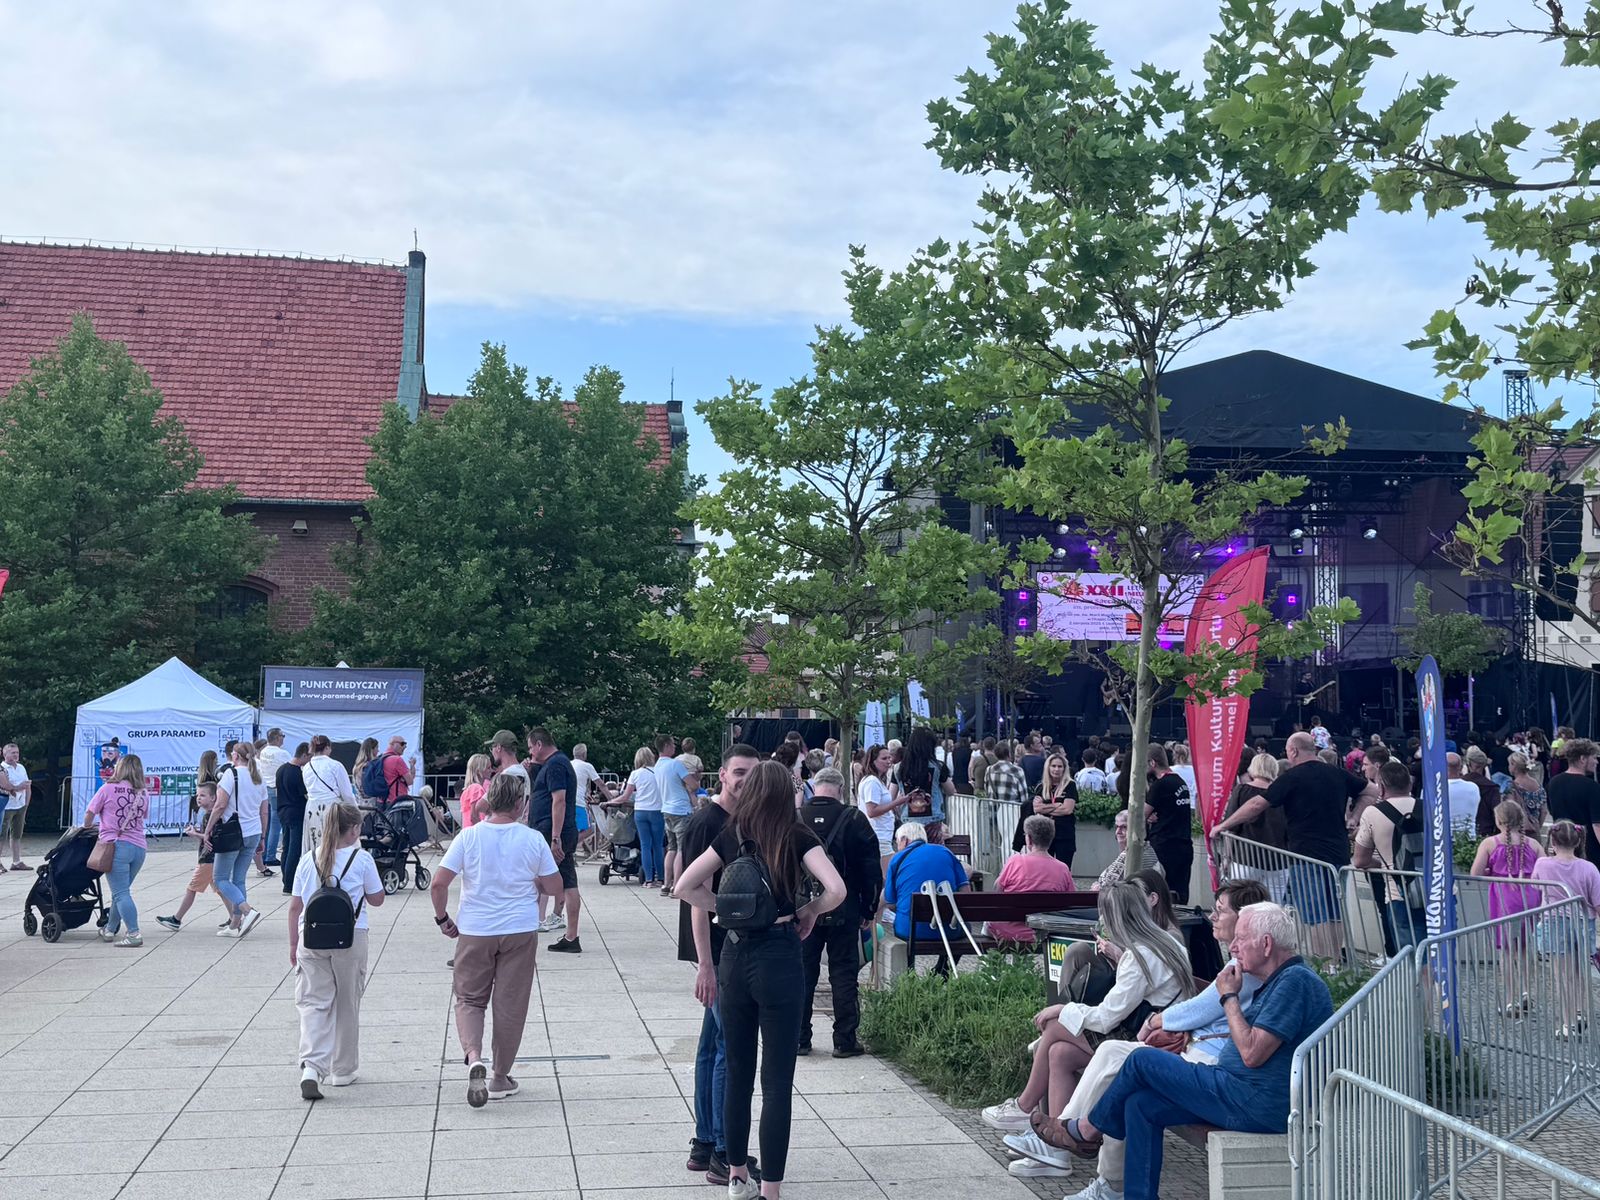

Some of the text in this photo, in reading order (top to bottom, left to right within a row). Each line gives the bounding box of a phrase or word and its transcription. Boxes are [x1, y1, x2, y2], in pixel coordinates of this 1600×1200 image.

[1086, 585, 1124, 596] XXII
[300, 681, 388, 690] PUNKT MEDYCZNY
[299, 692, 388, 700] www.paramed-group.pl
[1210, 695, 1223, 752] Kultur
[127, 730, 206, 738] GRUPA PARAMED
